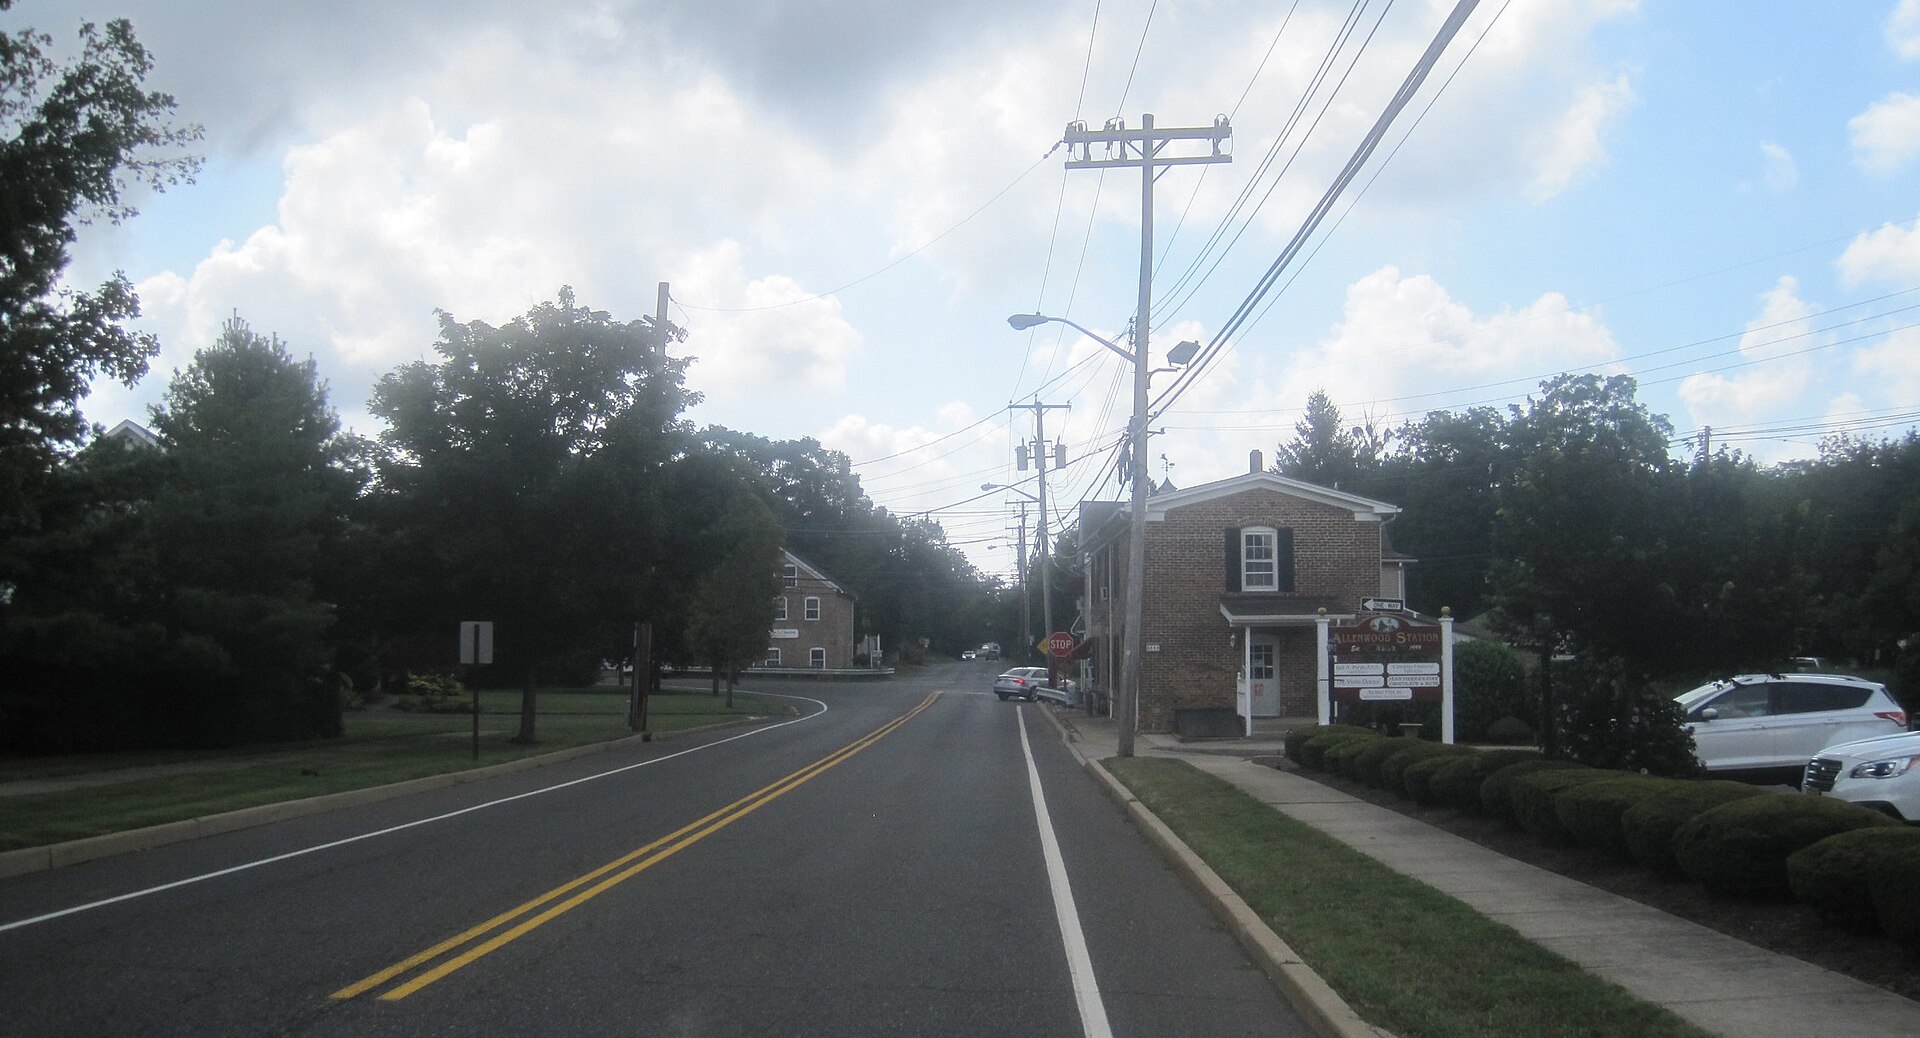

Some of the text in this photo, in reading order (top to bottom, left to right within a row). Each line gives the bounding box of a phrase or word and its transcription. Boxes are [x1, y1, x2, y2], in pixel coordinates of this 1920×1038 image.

[1334, 632, 1438, 643] ALLENWOOD STATION
[1050, 640, 1072, 649] STOP
